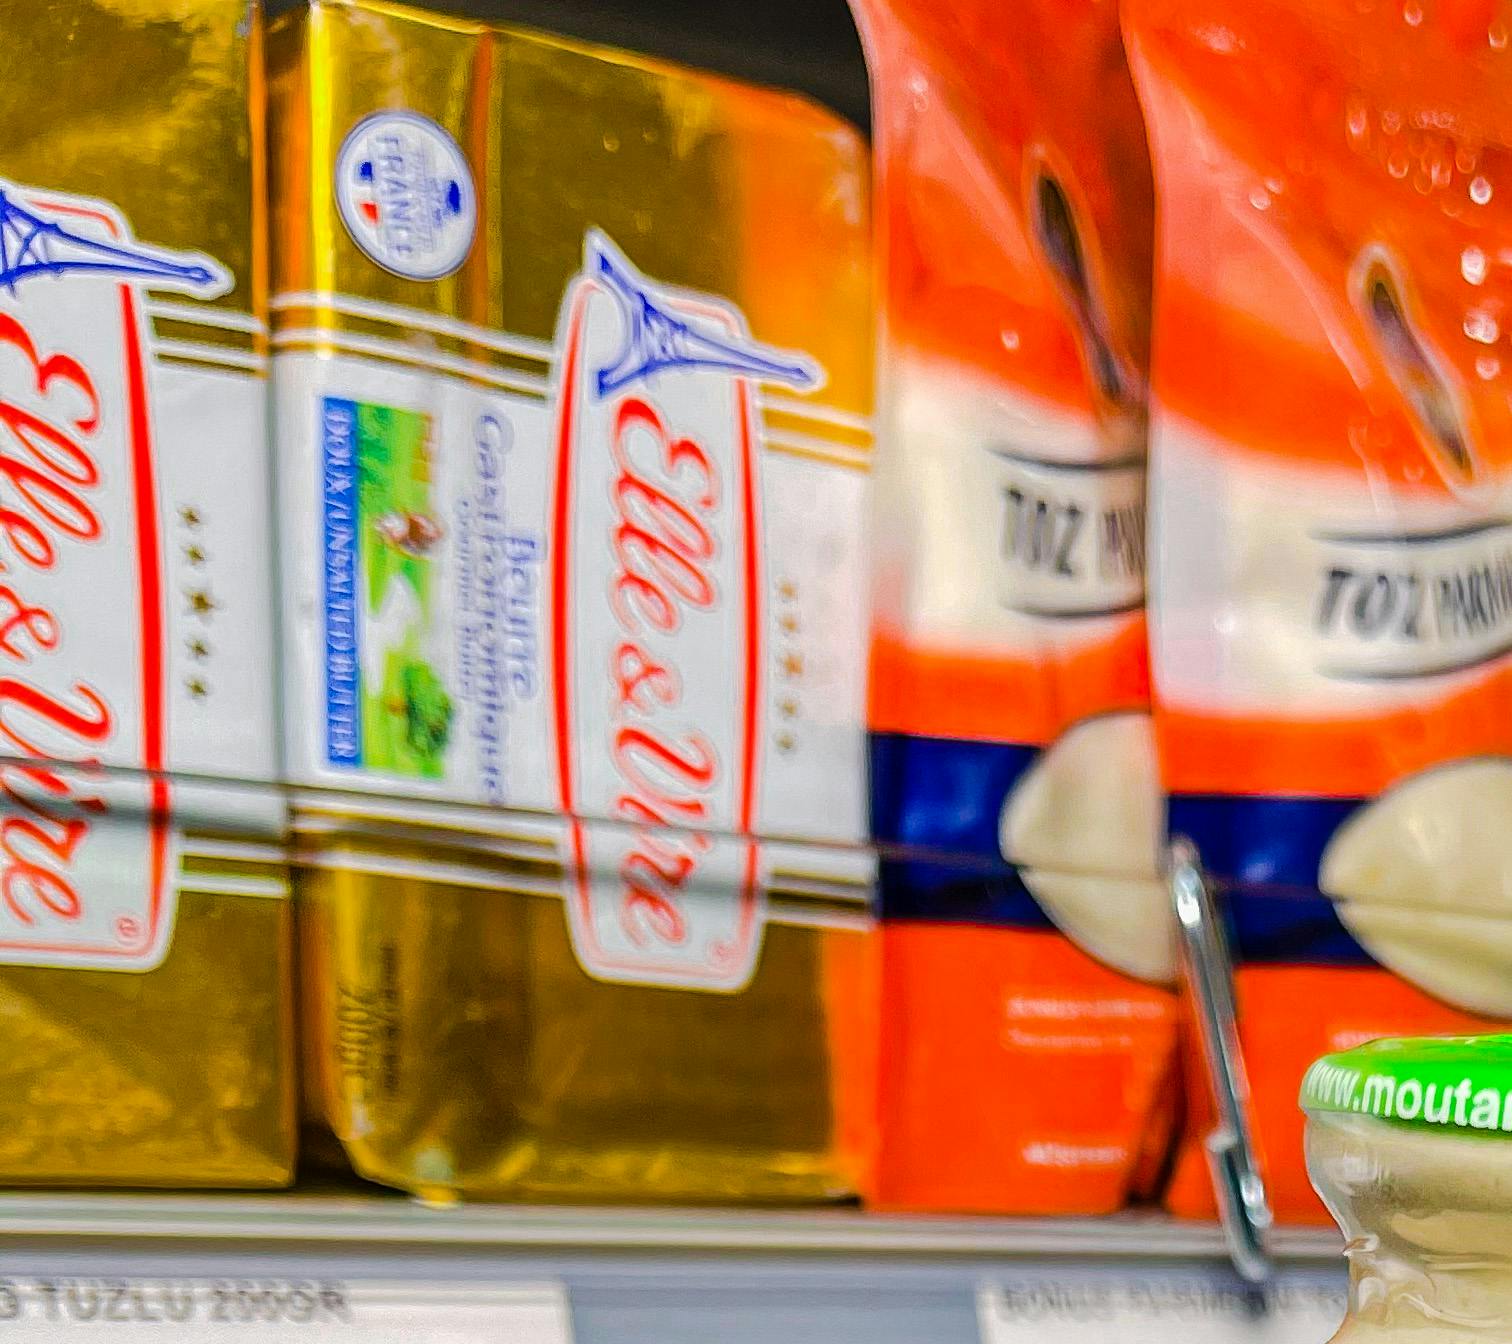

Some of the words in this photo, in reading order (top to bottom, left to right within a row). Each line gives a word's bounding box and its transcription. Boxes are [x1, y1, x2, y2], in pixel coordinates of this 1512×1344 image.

[613, 397, 718, 634] Elle
[1320, 564, 1423, 640] TOZ
[613, 726, 717, 949] Vire
